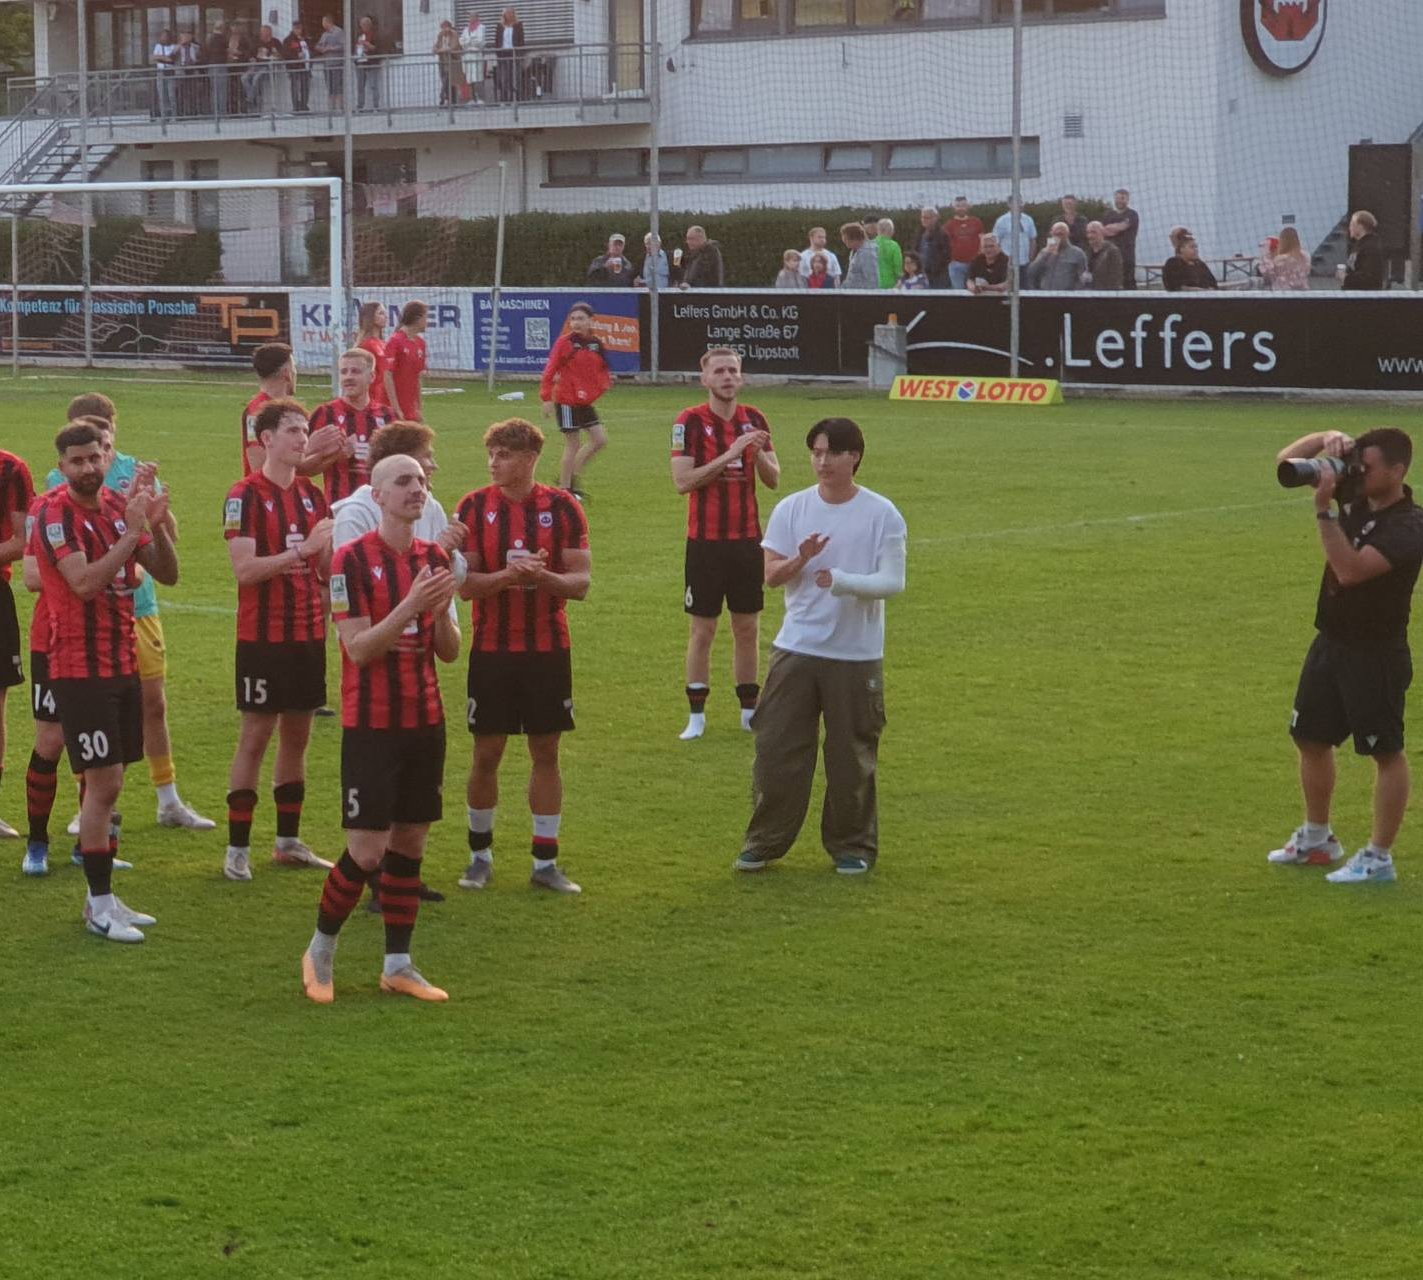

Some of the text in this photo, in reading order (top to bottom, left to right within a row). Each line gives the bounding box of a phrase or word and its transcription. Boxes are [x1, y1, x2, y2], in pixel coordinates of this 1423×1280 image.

[63, 297, 81, 313] für
[87, 299, 145, 315] lassische
[148, 299, 196, 315] Porsche
[479, 299, 550, 310] BAMASCHINEN
[673, 304, 799, 319] Leffers GmbH & Co. KG
[706, 324, 799, 342] Lange Straße 67
[748, 344, 800, 361] Lippstadt
[898, 378, 1048, 403] WEST LOTTO
[684, 585, 694, 609] 6
[34, 683, 57, 715] 14
[242, 676, 268, 705] 15
[78, 730, 109, 761] 30
[347, 788, 361, 820] 5
